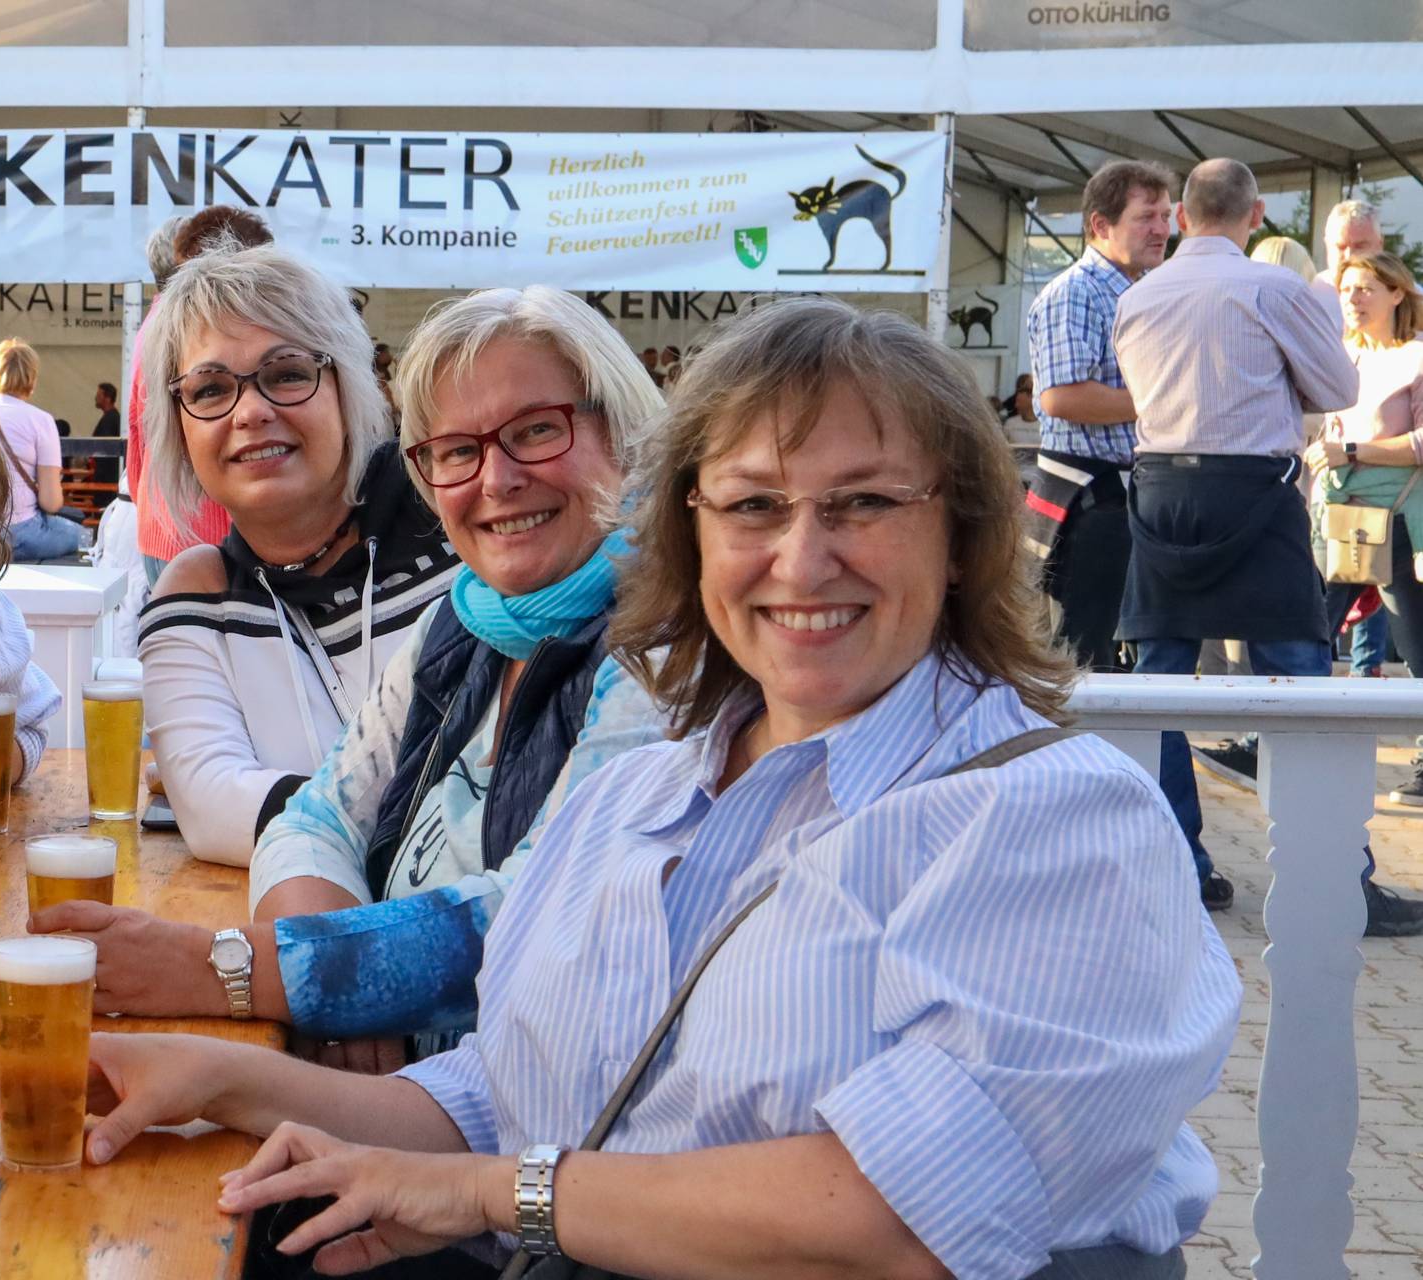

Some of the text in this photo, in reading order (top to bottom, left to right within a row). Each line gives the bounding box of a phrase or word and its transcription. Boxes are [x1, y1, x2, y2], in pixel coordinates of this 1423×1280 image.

[1028, 7, 1080, 25] OTTO
[548, 150, 646, 176] Herzlich
[547, 172, 748, 202] willkommen zum
[545, 197, 737, 228] Schützenfest im
[350, 224, 518, 250] 3. Kompanie
[545, 222, 722, 256] Feuerwehrzelt!
[75, 318, 123, 330] Kompan
